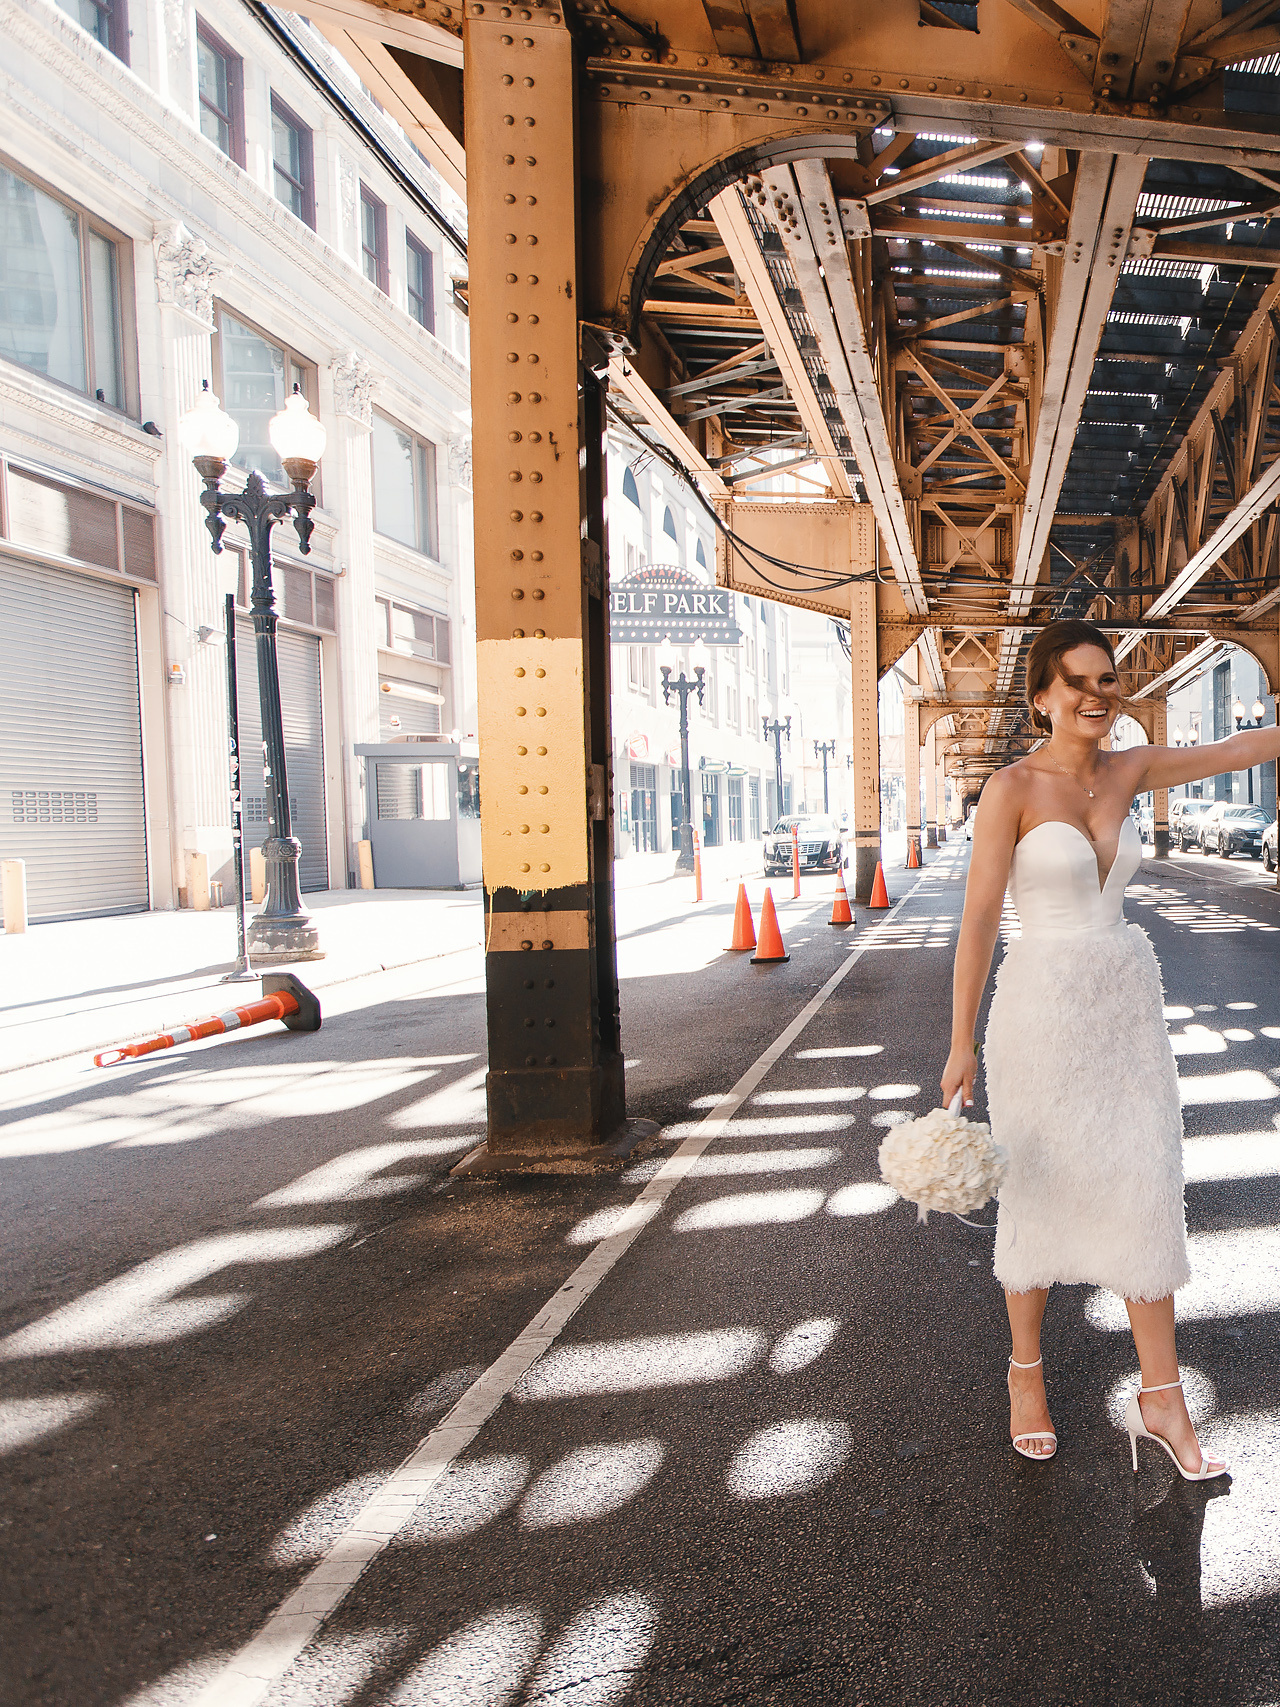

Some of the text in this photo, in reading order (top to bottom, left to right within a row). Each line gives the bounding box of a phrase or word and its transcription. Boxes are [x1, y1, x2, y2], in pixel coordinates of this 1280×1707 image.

[635, 569, 687, 583] THEATRE
[608, 592, 726, 615] ELF PARK
